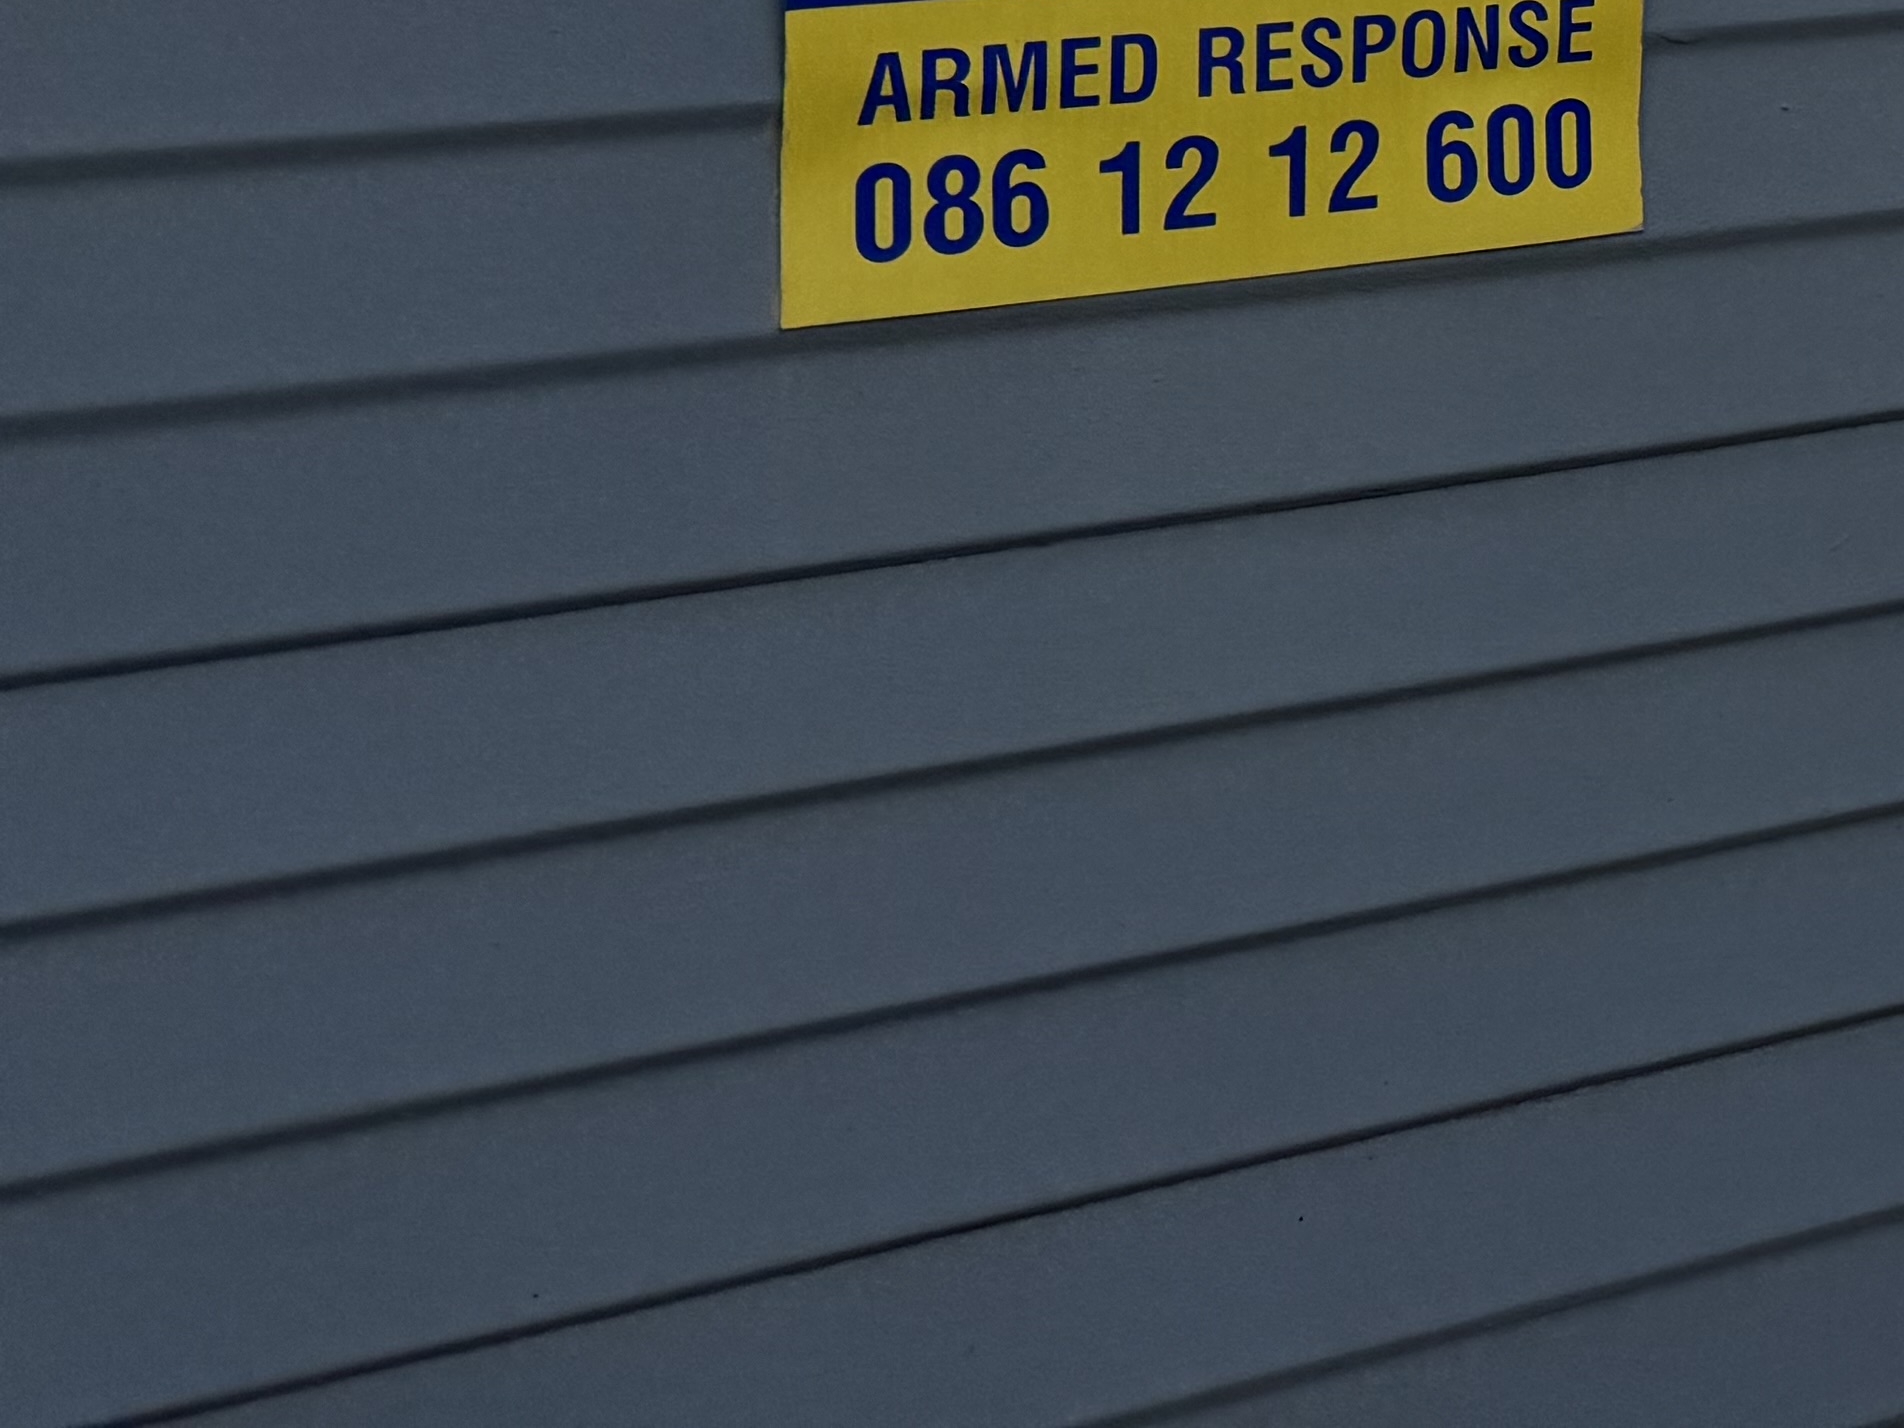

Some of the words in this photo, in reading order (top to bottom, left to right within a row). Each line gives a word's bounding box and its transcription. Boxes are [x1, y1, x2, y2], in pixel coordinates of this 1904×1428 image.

[857, 32, 1158, 127] ARMED
[855, 148, 1050, 264] 086
[1099, 134, 1220, 236] 12
[1268, 119, 1380, 218] 12
[1426, 97, 1593, 203] 600
